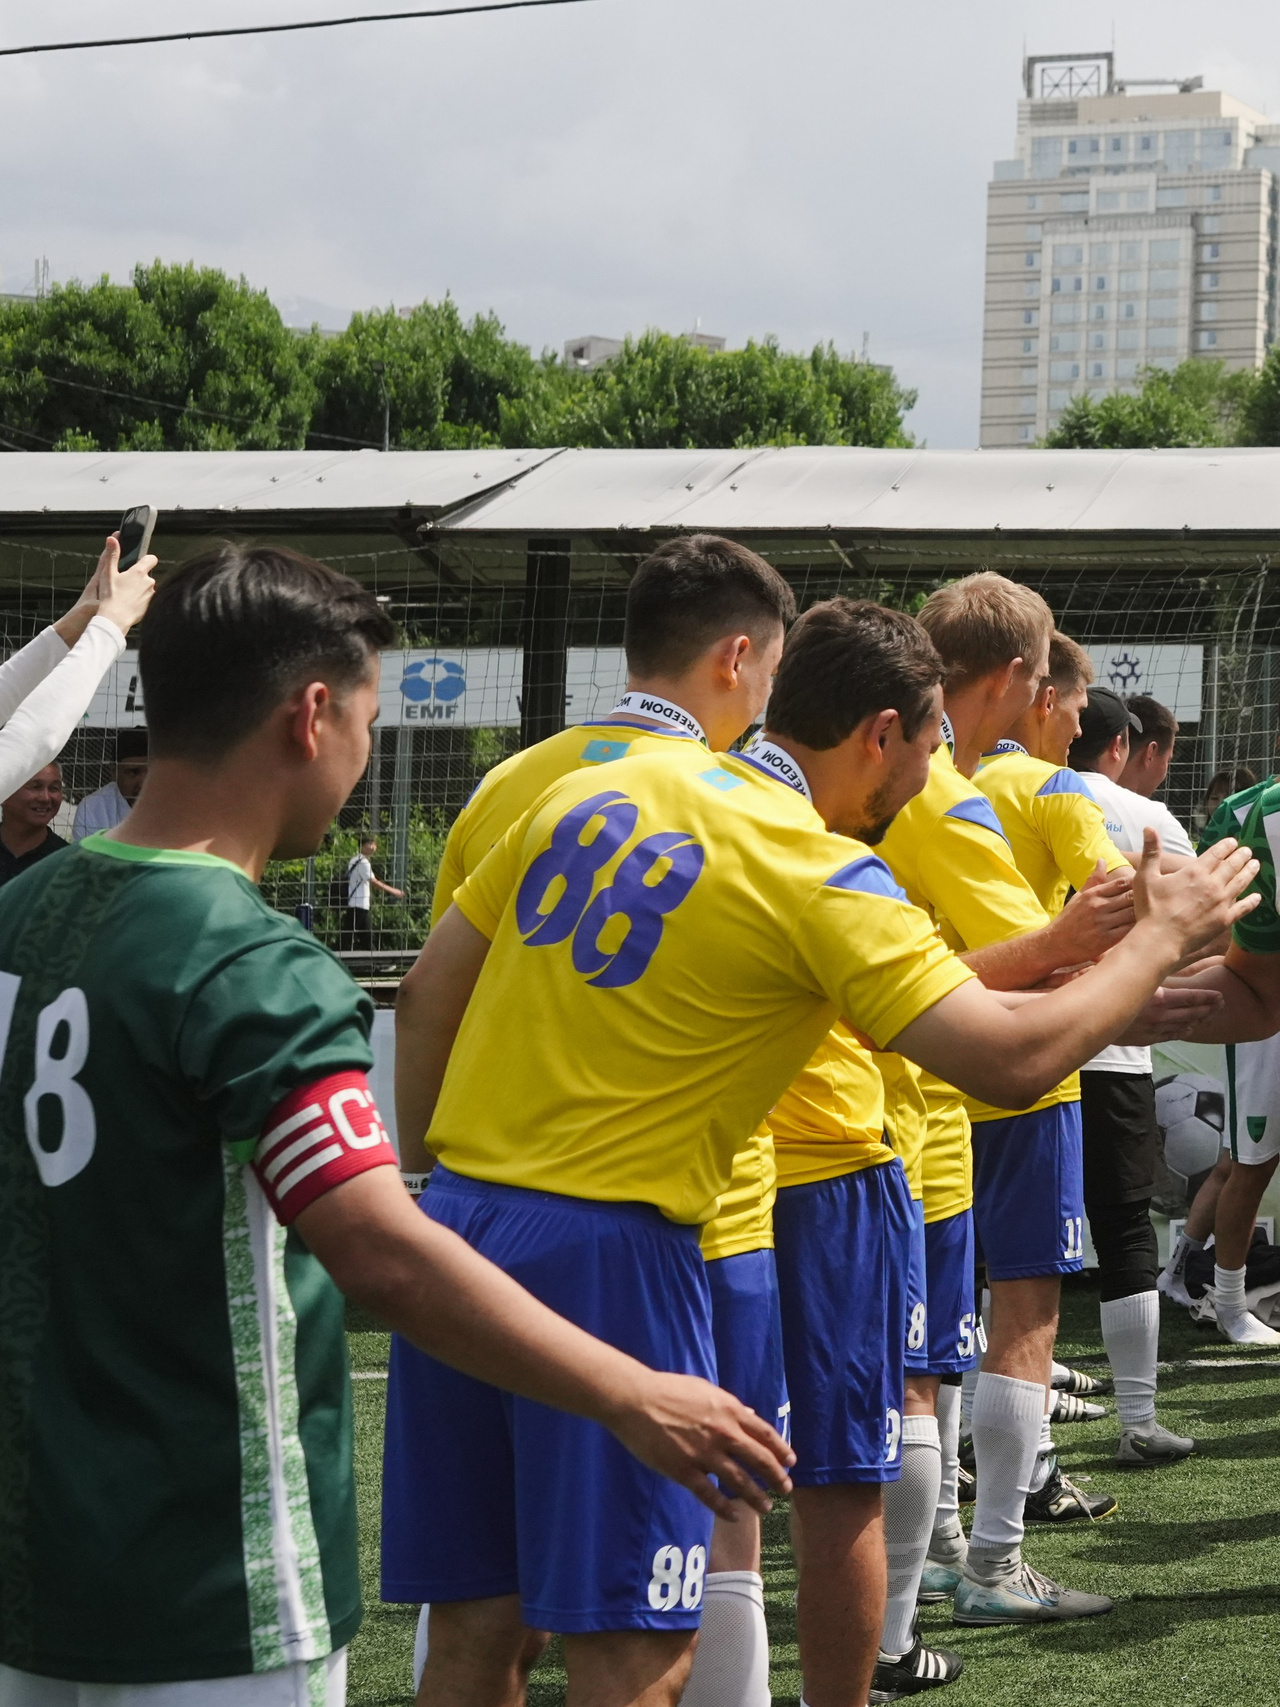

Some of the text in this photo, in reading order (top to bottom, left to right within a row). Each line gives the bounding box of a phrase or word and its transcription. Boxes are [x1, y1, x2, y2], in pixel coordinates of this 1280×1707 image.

[405, 705, 459, 719] EMF
[640, 699, 700, 737] FREEDOM
[516, 790, 705, 988] 88
[328, 1088, 382, 1150] C
[1063, 1217, 1083, 1259] 11
[907, 1302, 925, 1351] 8
[648, 1544, 706, 1612] 88
